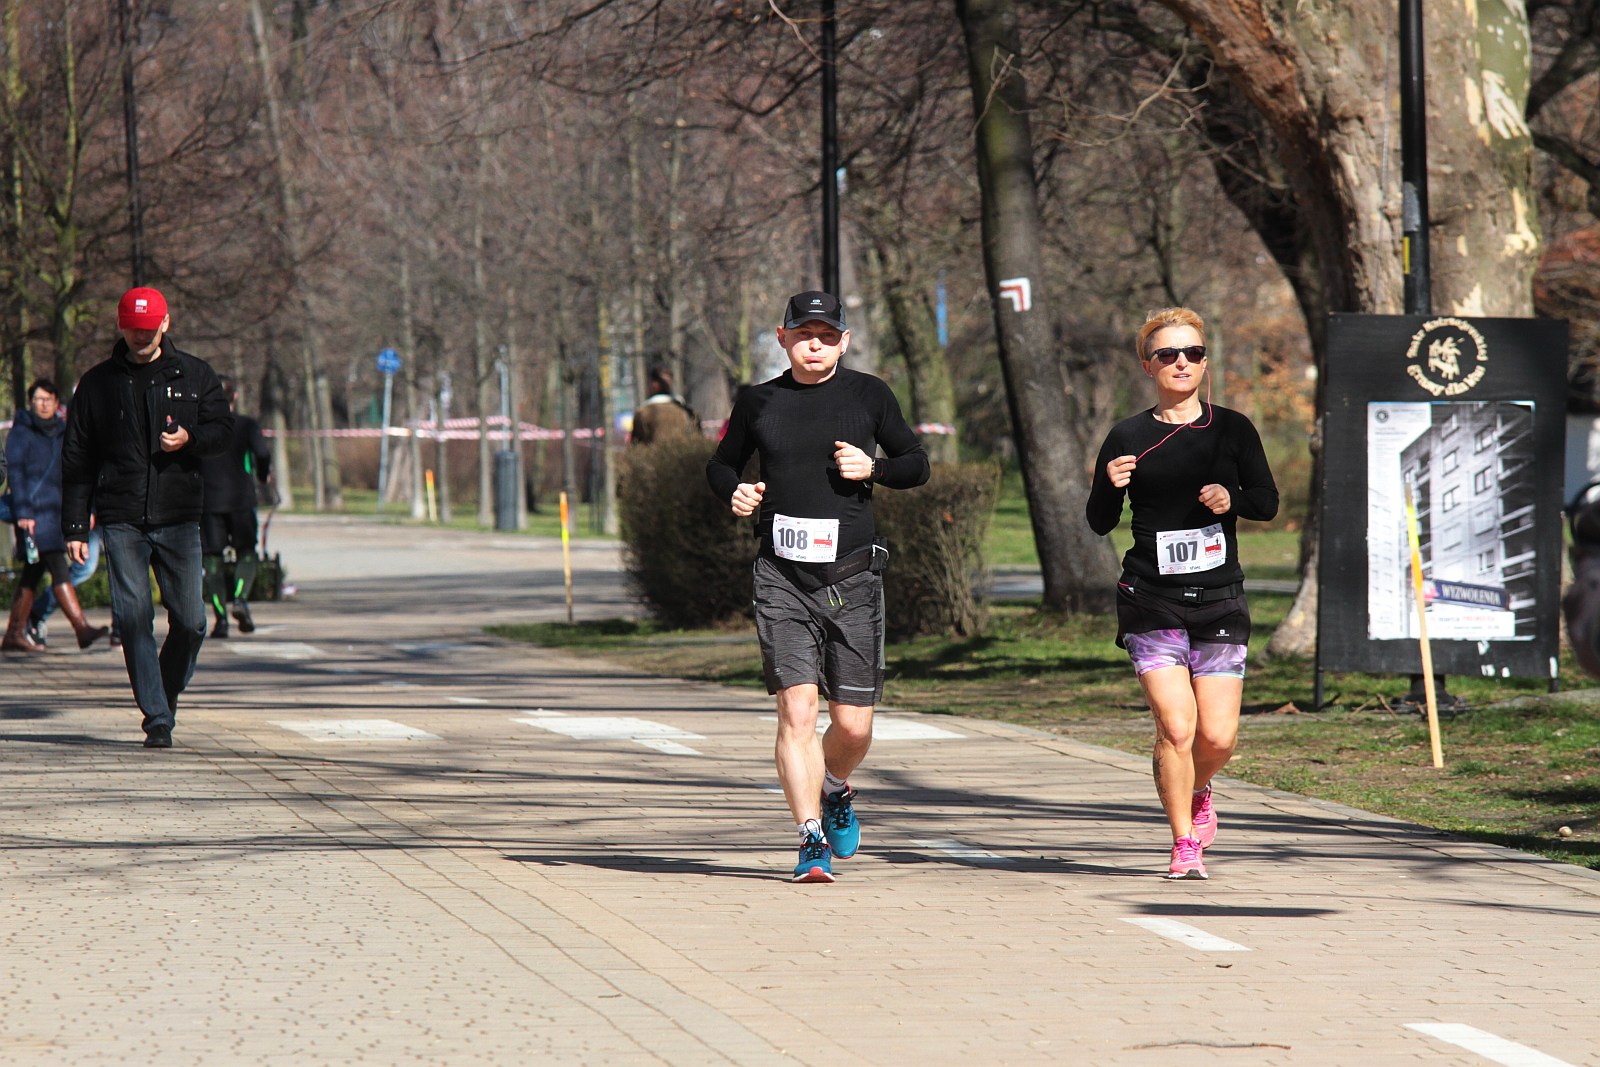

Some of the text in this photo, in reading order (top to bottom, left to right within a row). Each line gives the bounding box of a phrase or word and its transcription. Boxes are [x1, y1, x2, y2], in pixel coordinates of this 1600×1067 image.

[777, 527, 808, 550] 108
[1165, 541, 1198, 563] 107
[1441, 584, 1501, 605] WYZWOLENIA
